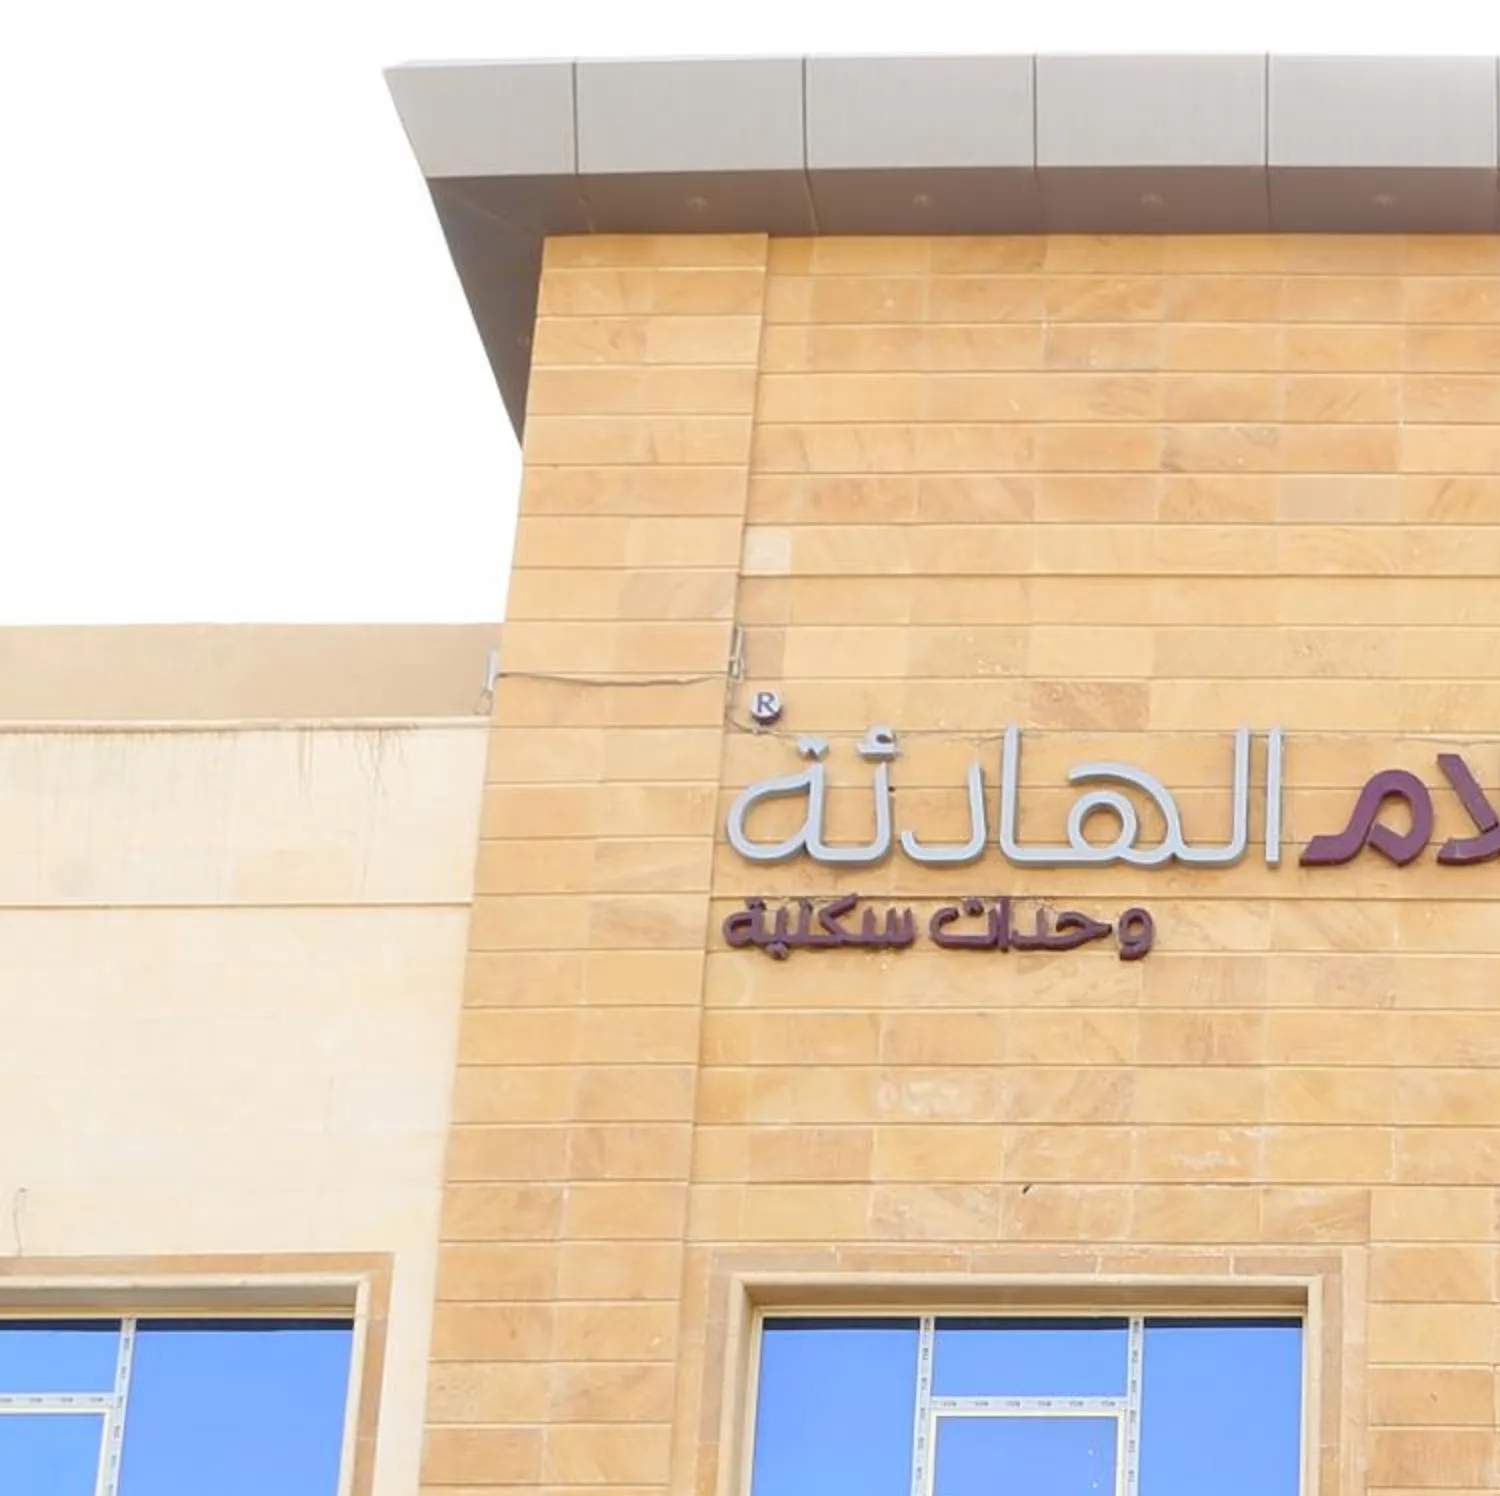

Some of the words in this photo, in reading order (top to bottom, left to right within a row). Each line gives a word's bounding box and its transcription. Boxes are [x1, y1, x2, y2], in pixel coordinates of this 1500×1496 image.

[726, 724, 1284, 869] الهادئة
[722, 892, 917, 961] سكنية
[929, 894, 1156, 961] وحدات
